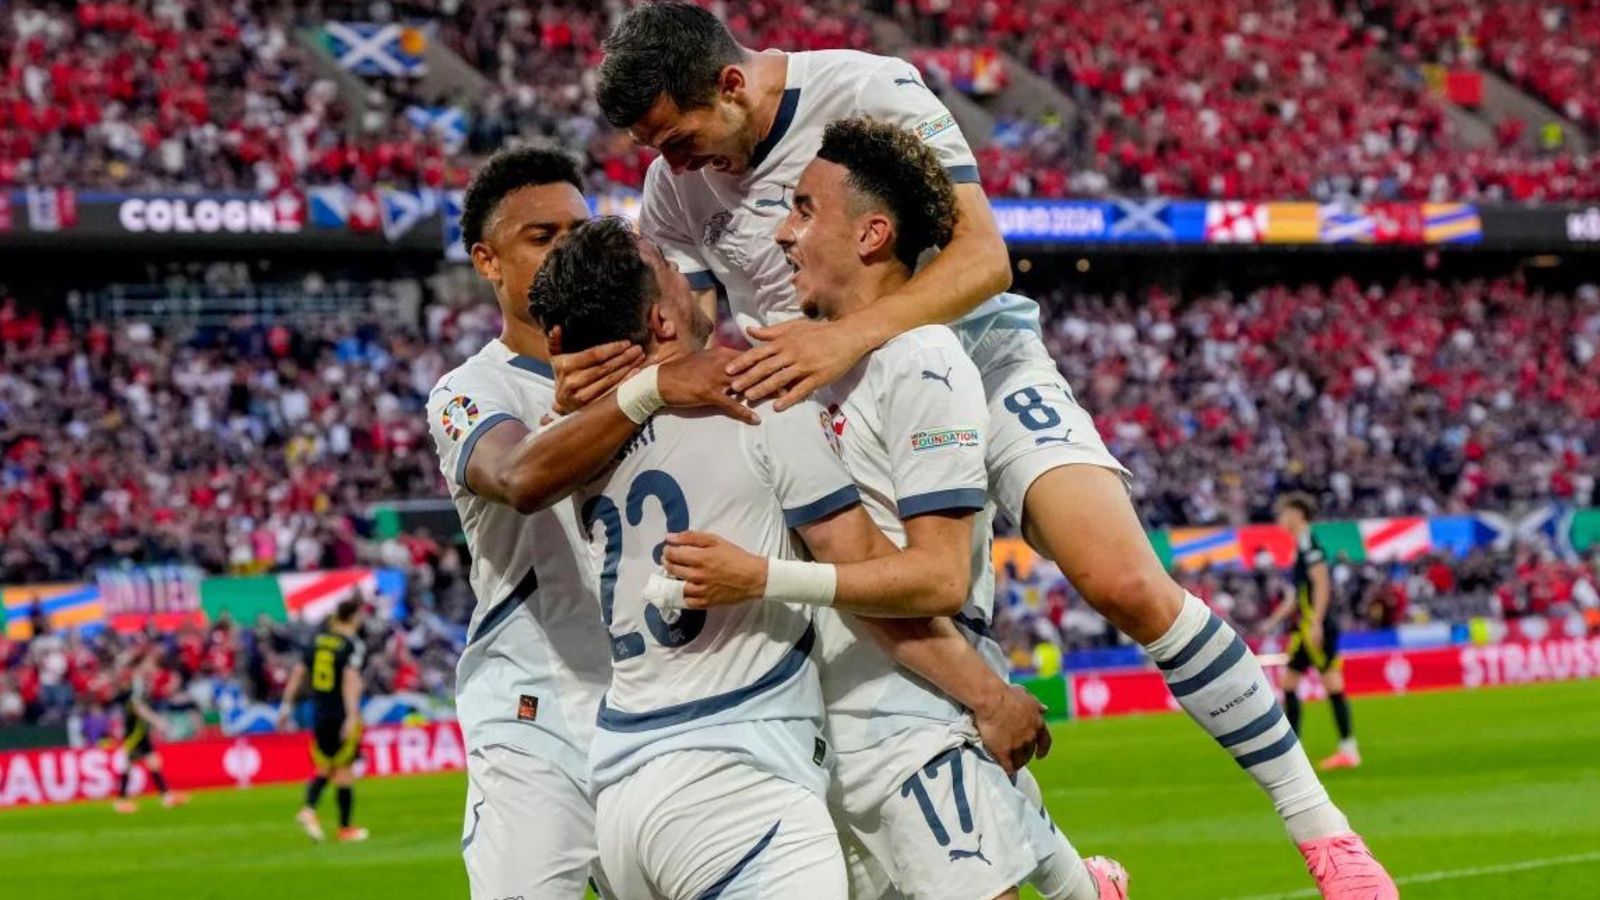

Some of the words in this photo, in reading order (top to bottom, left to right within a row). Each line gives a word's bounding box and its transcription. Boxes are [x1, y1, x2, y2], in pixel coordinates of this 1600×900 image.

[119, 198, 301, 233] COLOGN
[993, 206, 1105, 235] URO2024
[1003, 386, 1062, 431] 8
[911, 430, 978, 449] FOUNDATION
[581, 469, 708, 663] 23
[313, 649, 336, 693] 6
[1209, 681, 1261, 718] SUISSE
[901, 747, 975, 847] 17
